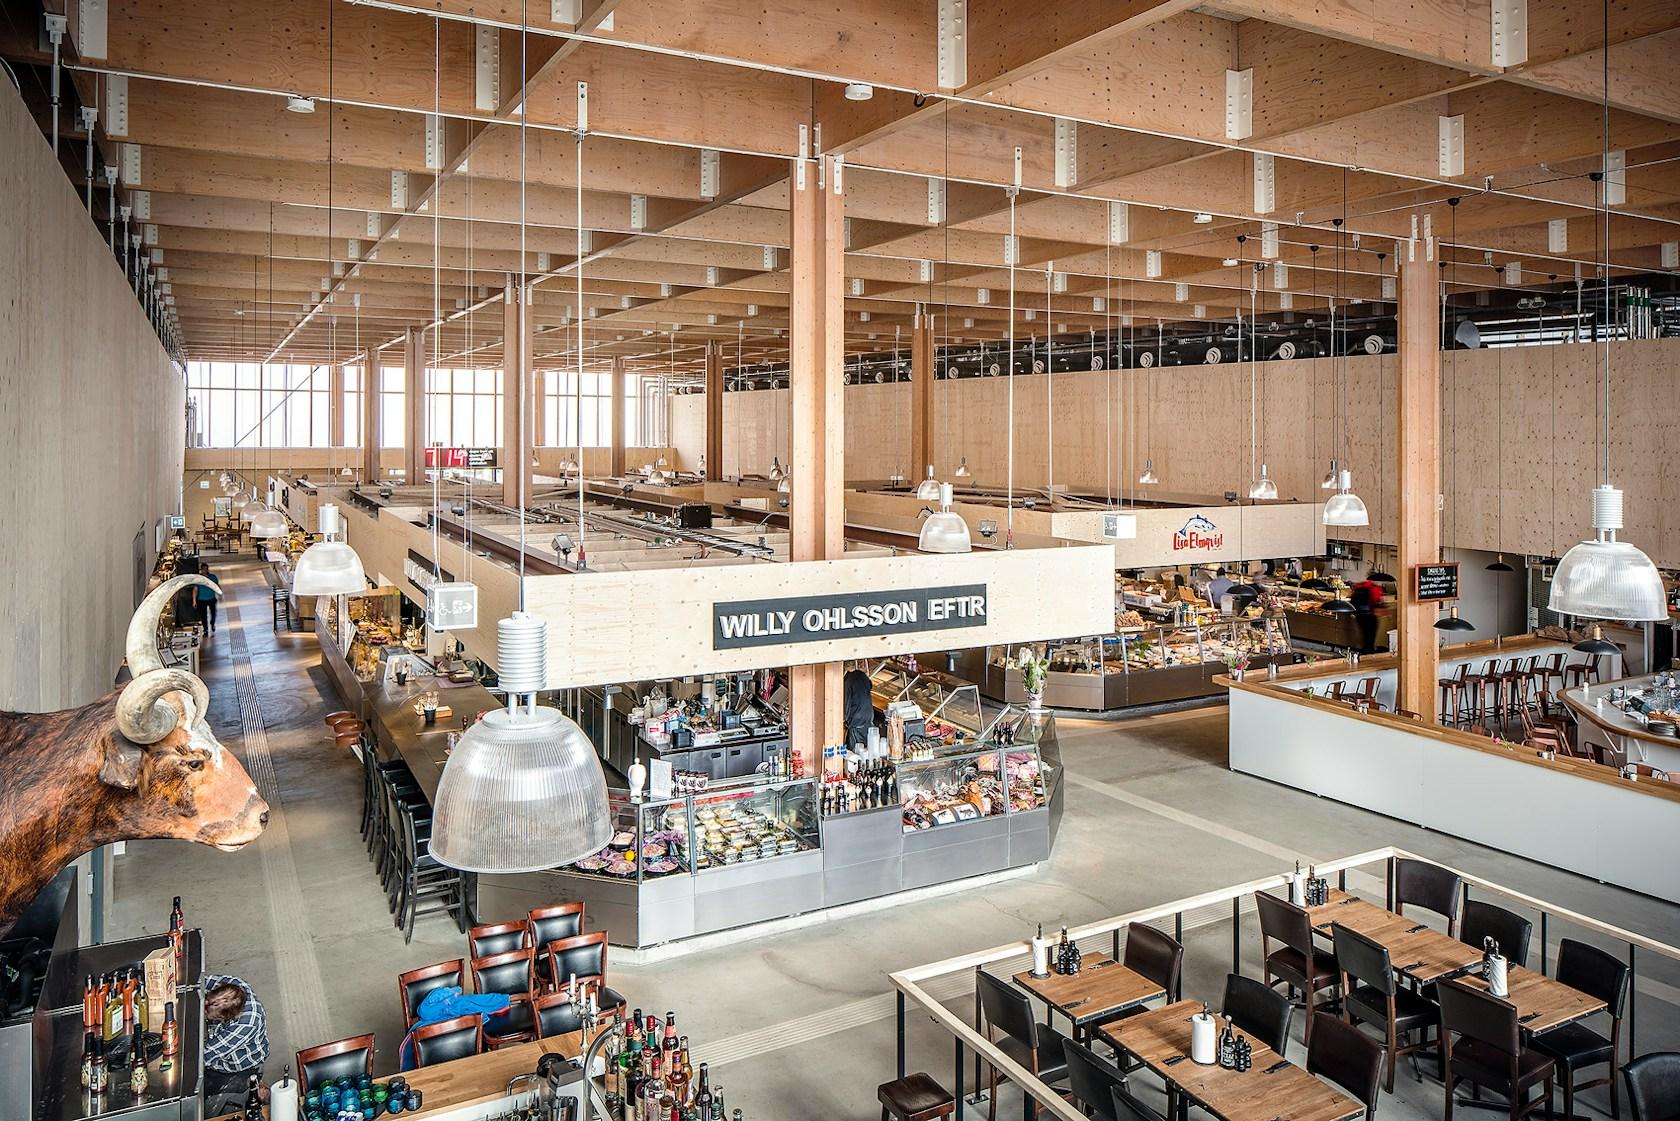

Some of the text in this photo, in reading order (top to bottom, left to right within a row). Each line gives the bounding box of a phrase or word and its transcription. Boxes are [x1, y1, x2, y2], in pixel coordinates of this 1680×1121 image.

[1173, 532, 1189, 551] Lisa
[719, 595, 986, 639] WILLY OHLSSON EFTR
